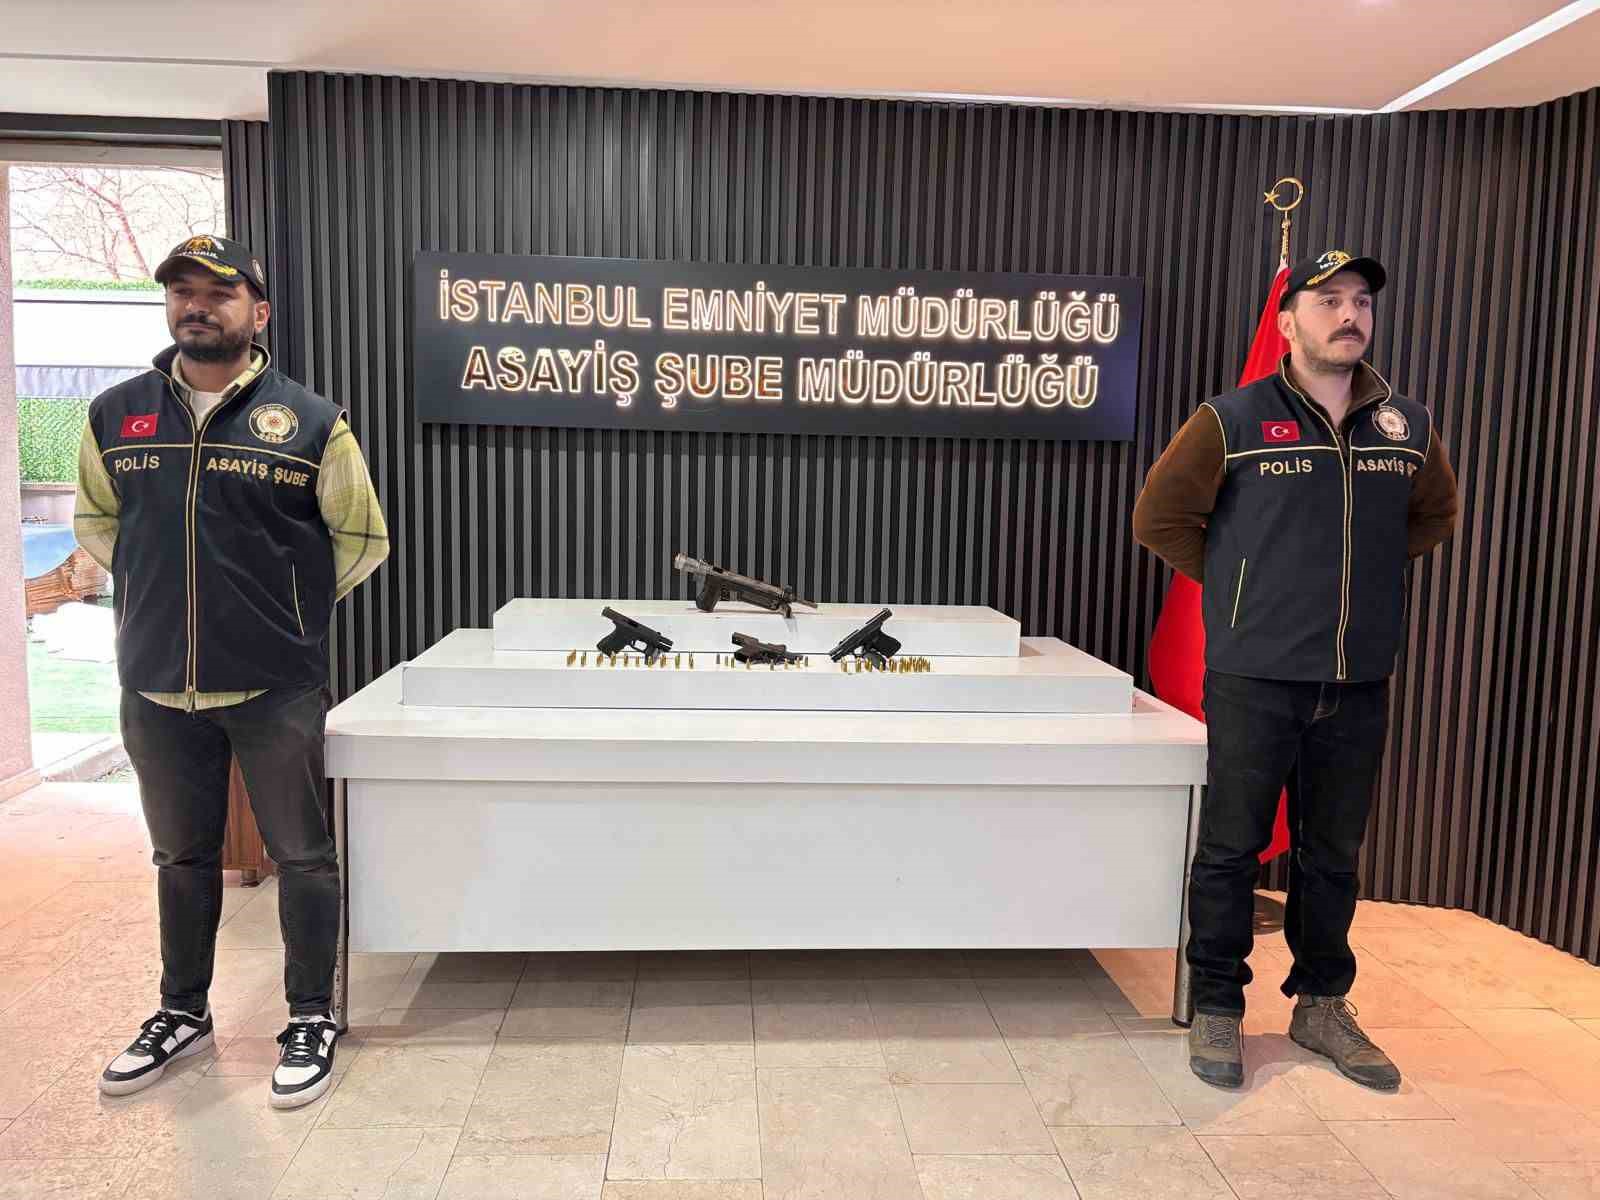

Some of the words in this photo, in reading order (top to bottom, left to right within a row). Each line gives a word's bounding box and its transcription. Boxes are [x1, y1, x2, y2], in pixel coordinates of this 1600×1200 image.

[439, 269, 651, 328] İSTANBUL
[663, 281, 847, 335] EMNİYET
[857, 287, 1120, 343] MÜDÜRLÜĞÜ
[461, 340, 640, 407] ASAYİŞ
[655, 352, 783, 408] ŞUBE
[798, 350, 1099, 408] MÜDÜRLÜĞÜ
[114, 452, 161, 473] POLİS
[206, 458, 269, 479] ASAYİŞ
[273, 467, 309, 486] ŞUBE
[1259, 457, 1313, 476] POLİS
[1356, 456, 1405, 476] ASAYİŞ
